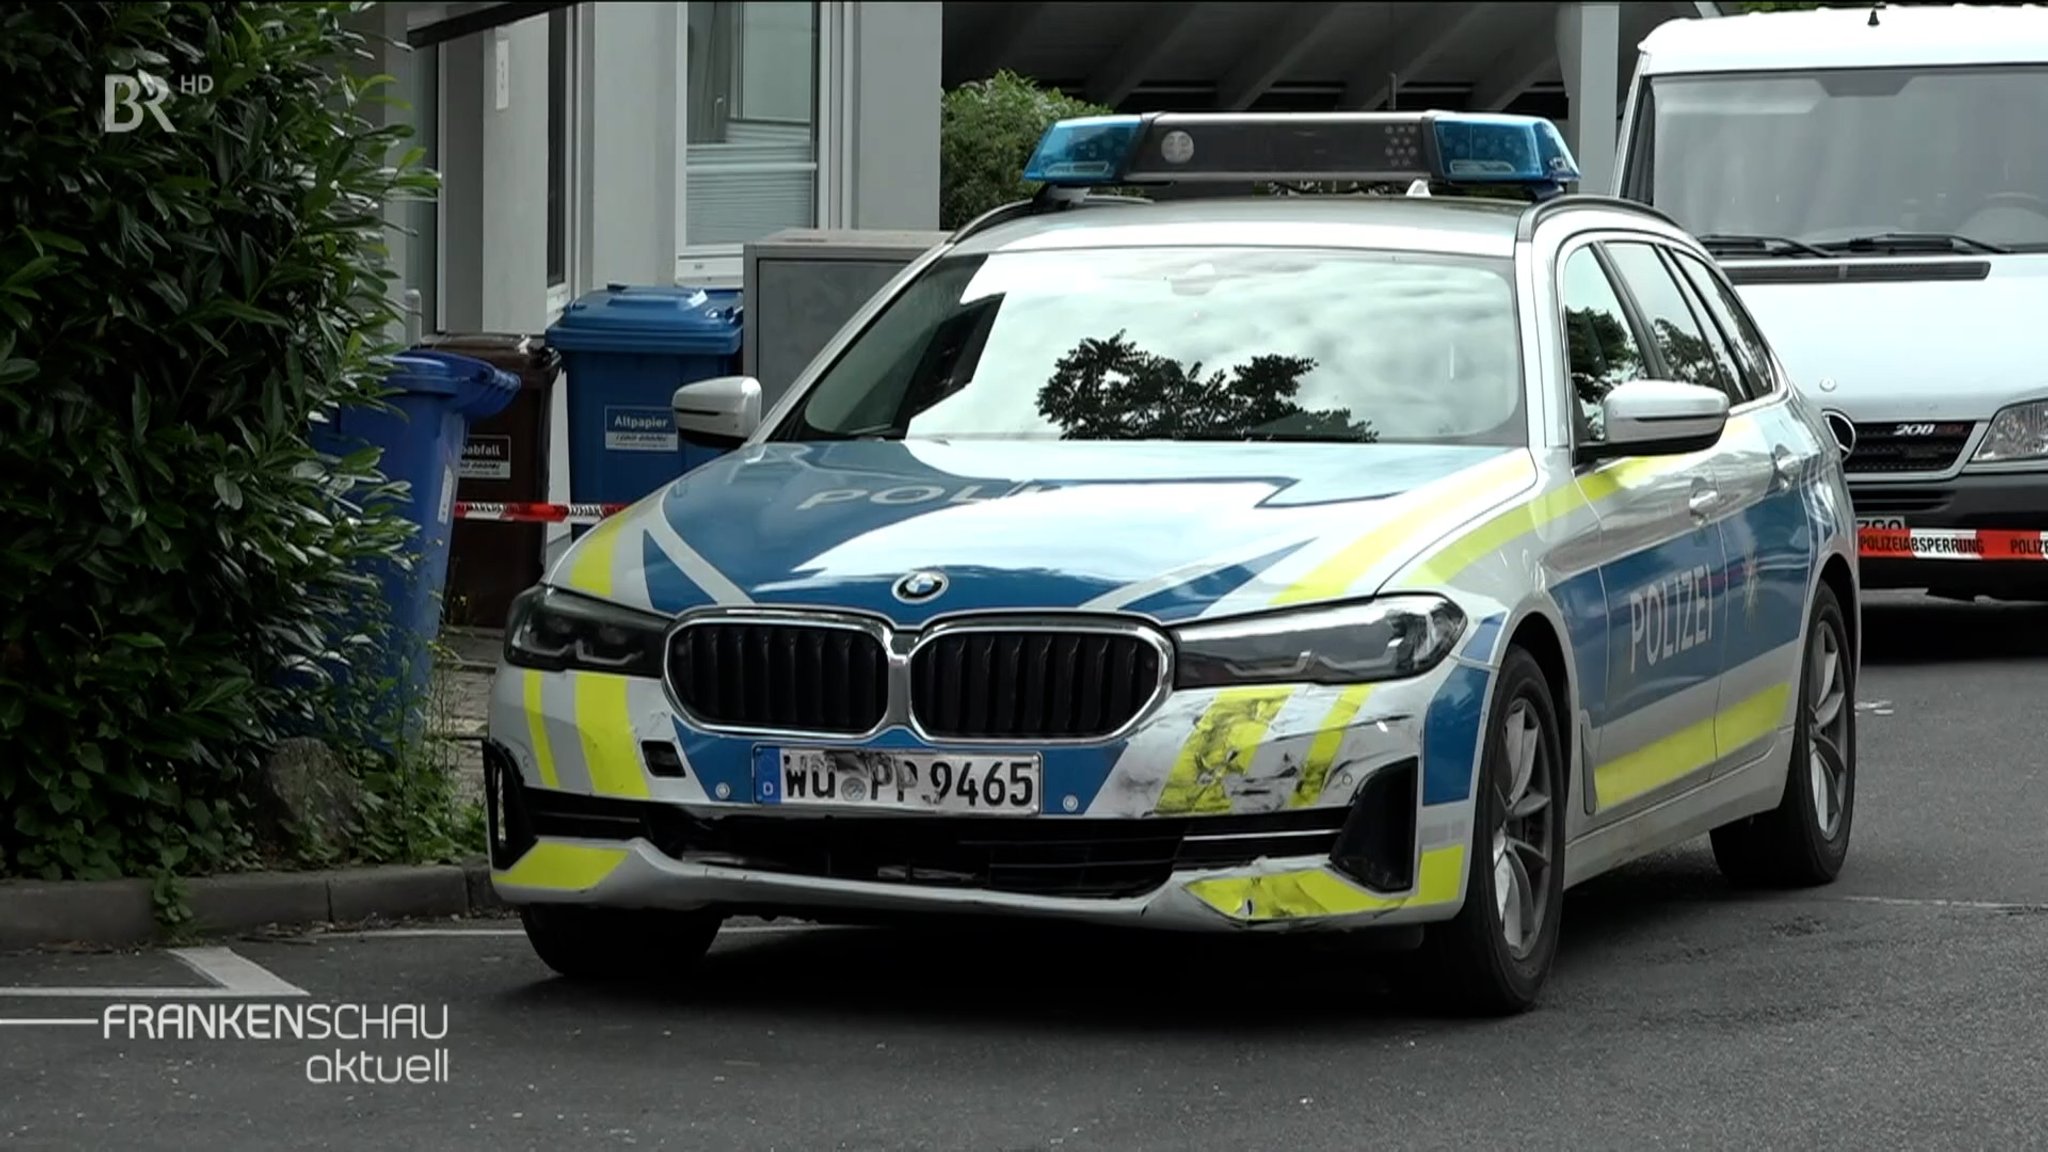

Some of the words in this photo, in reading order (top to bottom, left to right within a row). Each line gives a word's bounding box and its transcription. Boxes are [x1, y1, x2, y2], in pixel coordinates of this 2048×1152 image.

[614, 414, 669, 430] Altpapier
[1859, 535, 1985, 555] POLIZEIABSPERRUNG
[1629, 562, 1713, 674] POLIZEI
[762, 782, 774, 795] D
[928, 760, 1034, 807] 9465
